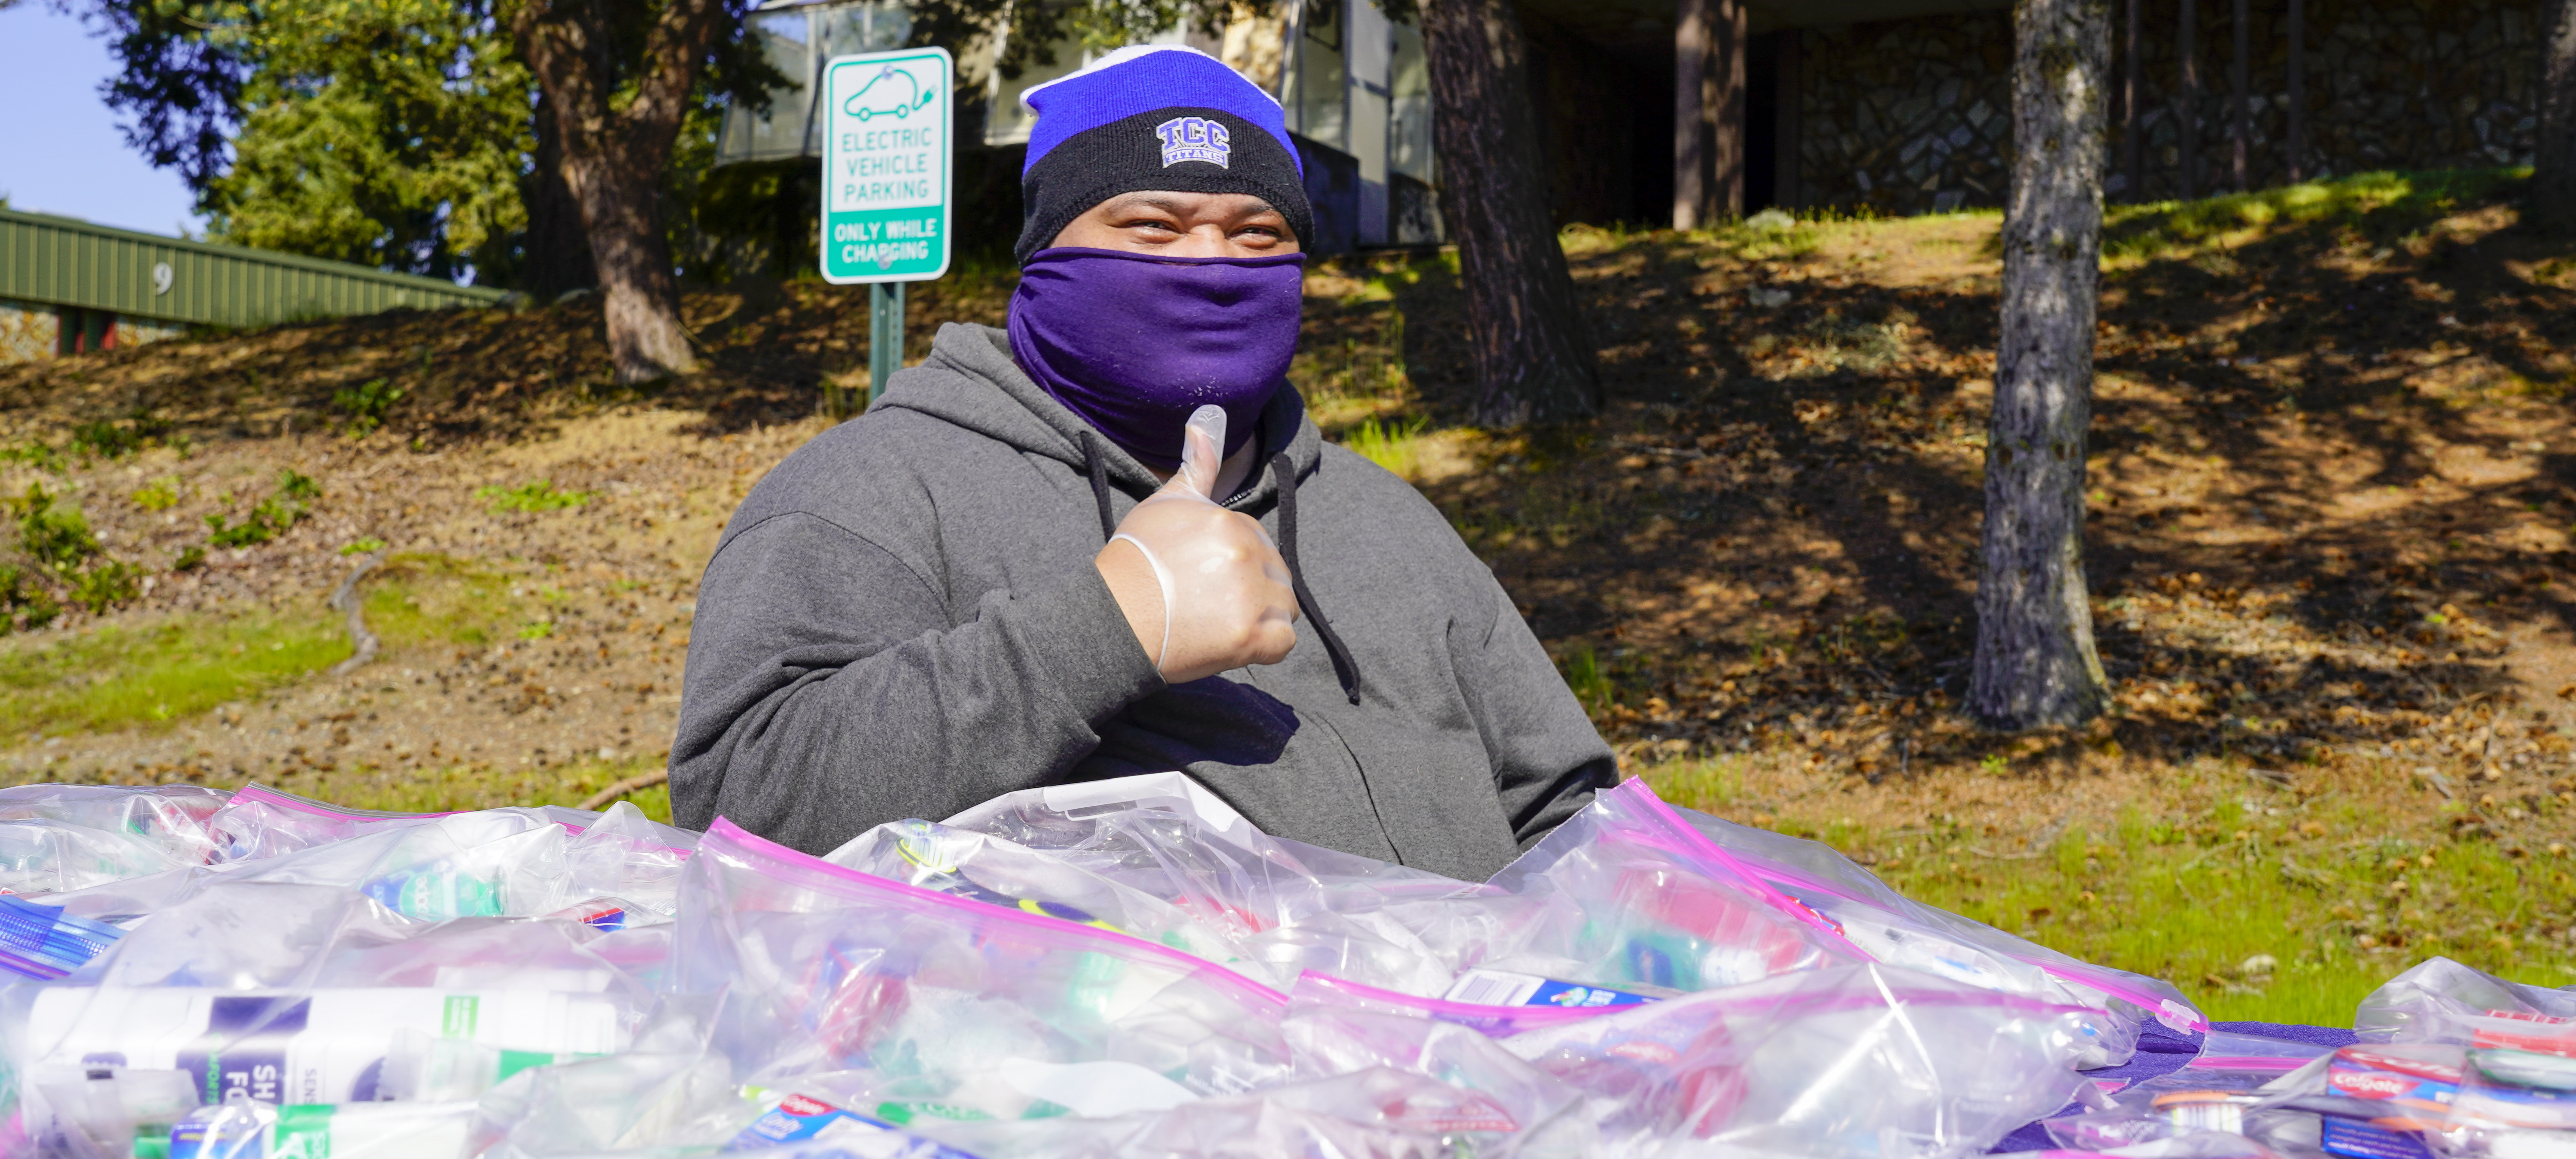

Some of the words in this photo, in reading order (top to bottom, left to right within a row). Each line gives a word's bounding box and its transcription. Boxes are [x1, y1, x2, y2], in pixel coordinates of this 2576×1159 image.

[842, 127, 932, 153] ELECTRIC
[1156, 117, 1231, 154] TCC
[846, 153, 928, 177] VEHICLE
[1165, 149, 1224, 163] TITANS
[844, 179, 929, 203] PARKING
[834, 221, 881, 242] ONLY
[885, 218, 938, 240] WHILE
[842, 240, 929, 264] CHARGING
[152, 262, 173, 295] 9
[2334, 1073, 2403, 1095] Colgate
